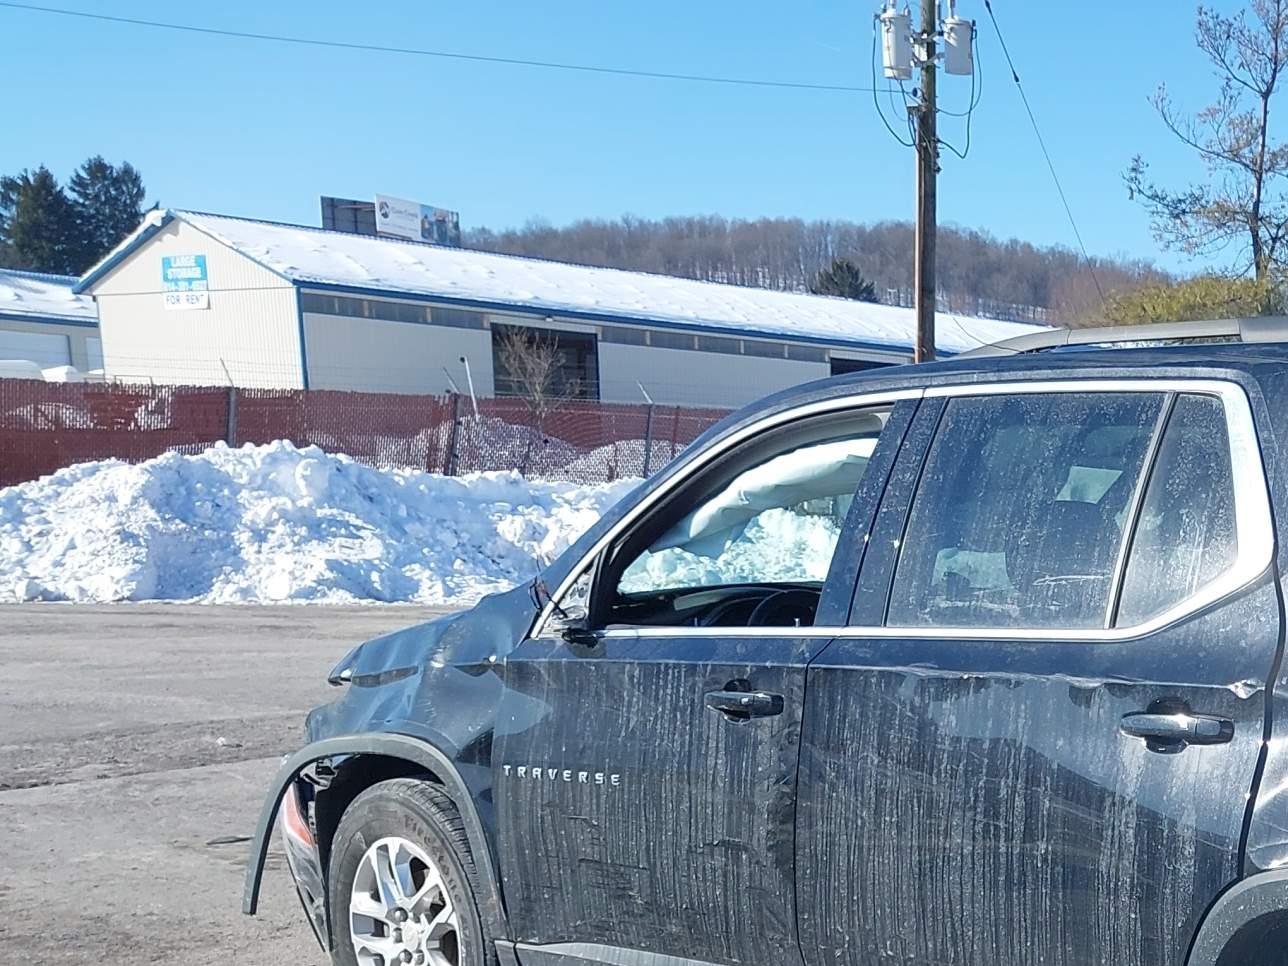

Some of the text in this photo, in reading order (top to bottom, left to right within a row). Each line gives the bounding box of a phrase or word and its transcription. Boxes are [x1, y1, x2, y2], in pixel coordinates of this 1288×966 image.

[166, 293, 205, 305] FOR RENT
[503, 764, 621, 786] TRAVERSE
